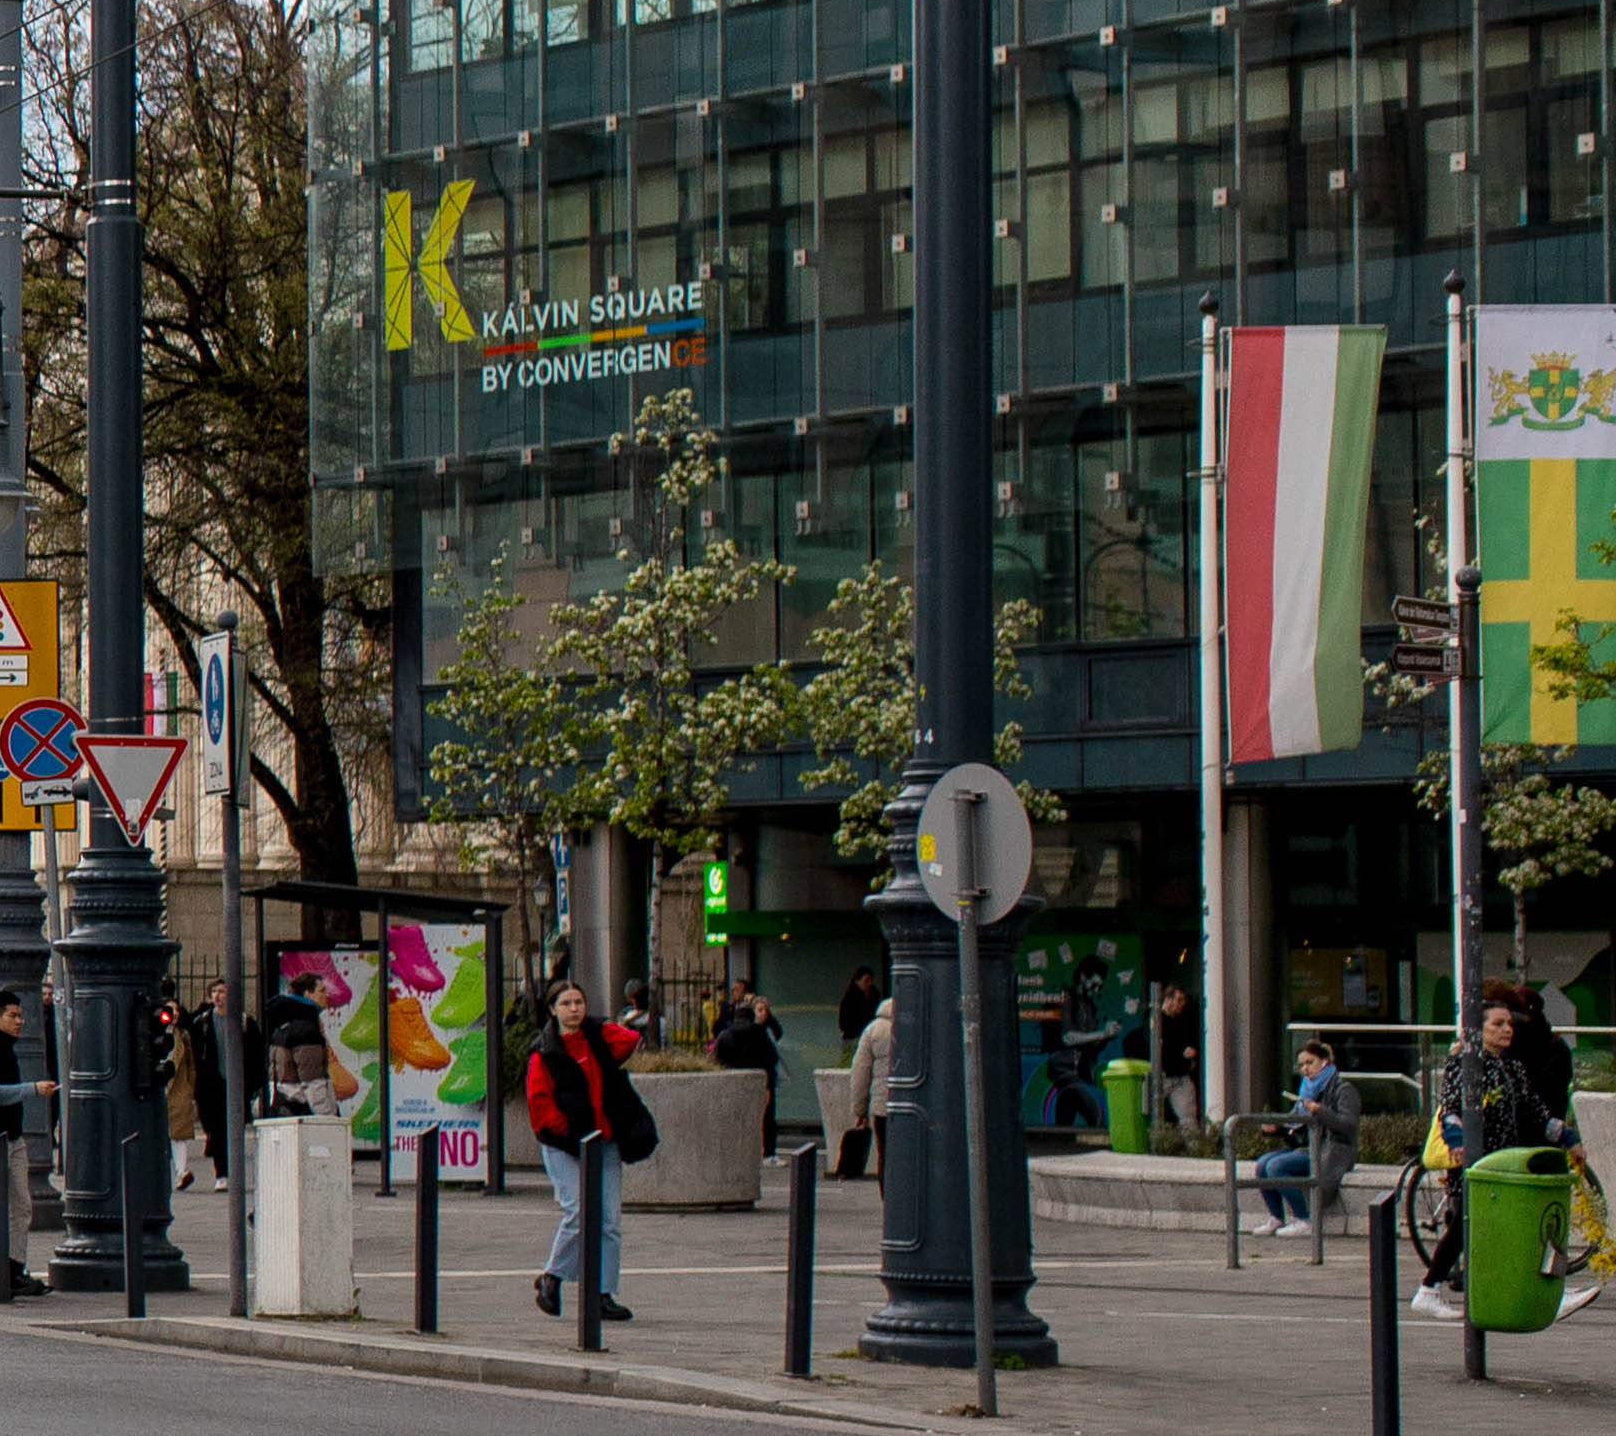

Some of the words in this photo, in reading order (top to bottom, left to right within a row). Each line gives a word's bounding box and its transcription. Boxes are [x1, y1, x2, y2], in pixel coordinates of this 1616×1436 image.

[384, 178, 477, 352] K
[482, 299, 579, 338] KÁLVIN
[590, 281, 703, 323] SQUARE
[482, 363, 511, 393] BY
[517, 337, 707, 388] CONVERGENCE
[394, 1135, 418, 1152] THE
[438, 1130, 480, 1168] NO
